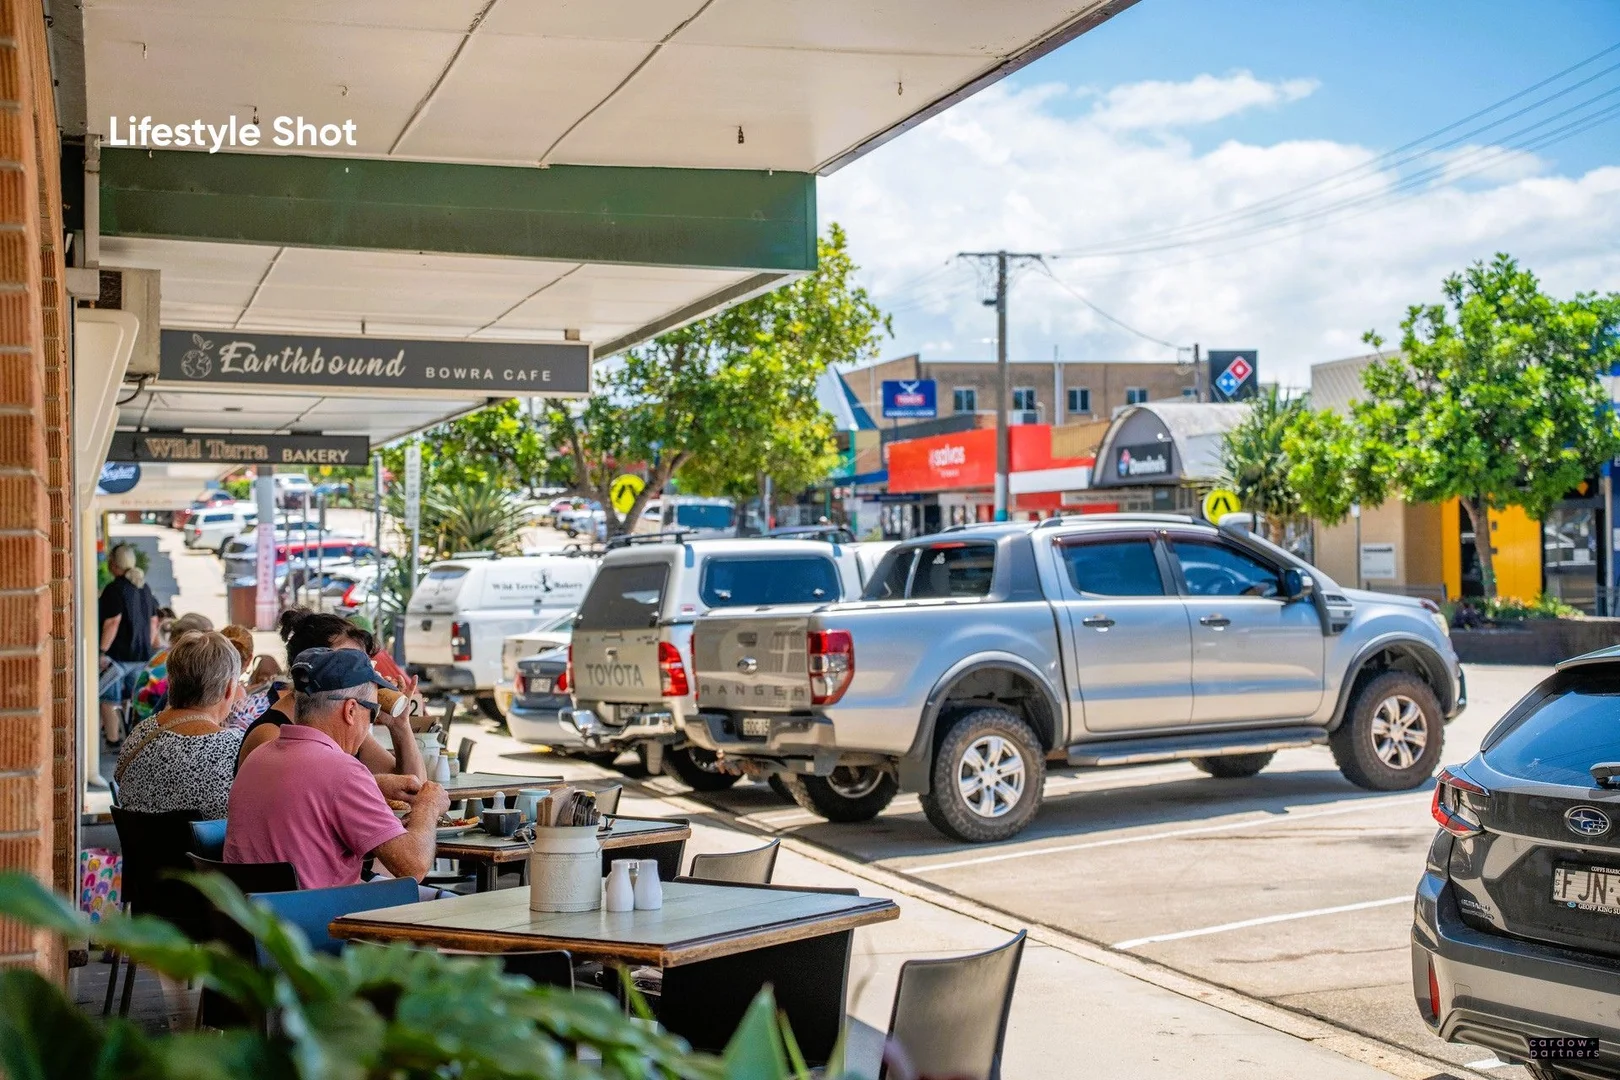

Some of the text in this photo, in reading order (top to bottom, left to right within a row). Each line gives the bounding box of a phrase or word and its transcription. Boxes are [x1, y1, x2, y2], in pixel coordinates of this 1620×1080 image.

[219, 341, 406, 377] Earthbound
[425, 366, 552, 382] BOWRA CAFE
[145, 437, 350, 463] Wild Terra BAKERY
[586, 663, 644, 687] TOYOTA
[700, 684, 805, 696] RANGER
[410, 699, 418, 717] 2
[1578, 903, 1597, 911] GEOFF
[1597, 905, 1613, 914] KING
